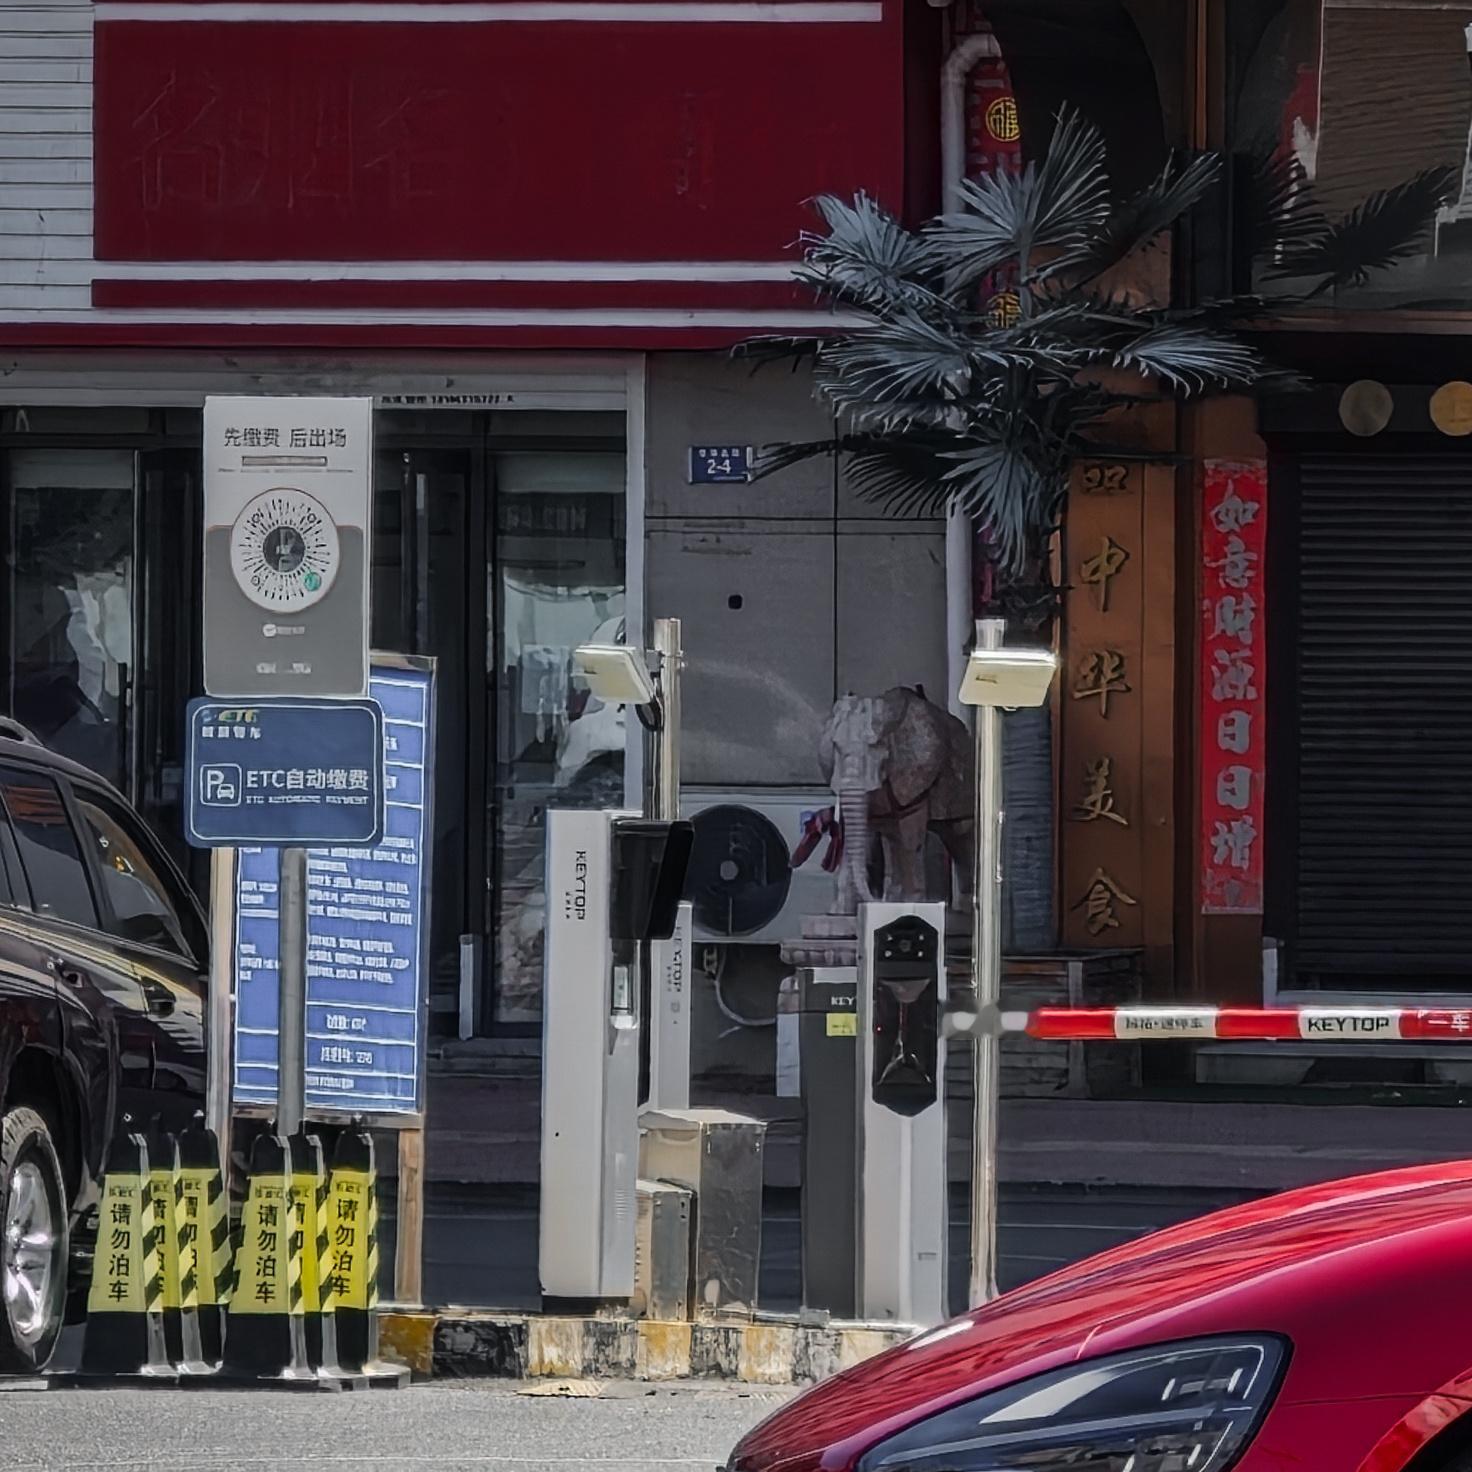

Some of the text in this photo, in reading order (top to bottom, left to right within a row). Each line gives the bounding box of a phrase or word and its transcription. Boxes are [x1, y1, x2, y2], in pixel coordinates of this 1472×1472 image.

[1308, 1016, 1390, 1033] KEYTOP
[108, 1202, 132, 1303] 请勿泊车
[254, 1203, 279, 1304] 请勿泊车
